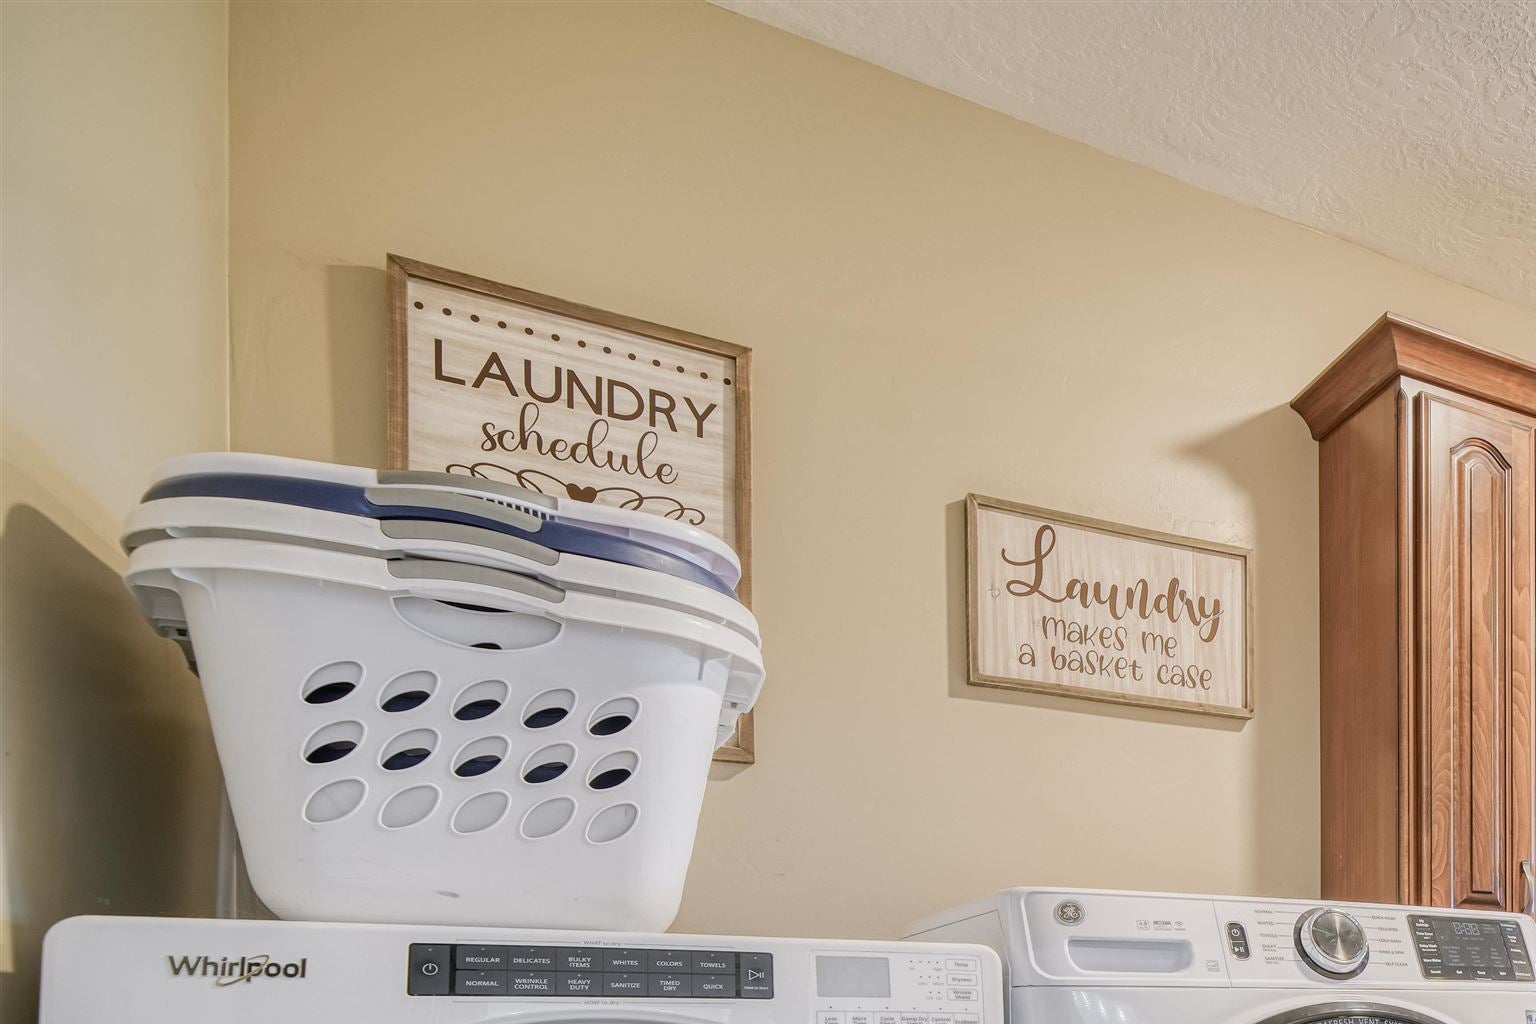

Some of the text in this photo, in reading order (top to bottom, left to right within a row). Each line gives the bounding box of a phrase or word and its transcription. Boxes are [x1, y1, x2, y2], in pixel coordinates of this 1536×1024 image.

[434, 338, 718, 439] LAUNDRY
[480, 402, 679, 484] schedule
[1001, 524, 1225, 643] Laundry
[1018, 643, 1213, 691] a basket case
[1042, 615, 1178, 659] makes me
[168, 954, 307, 985] Whirlpool
